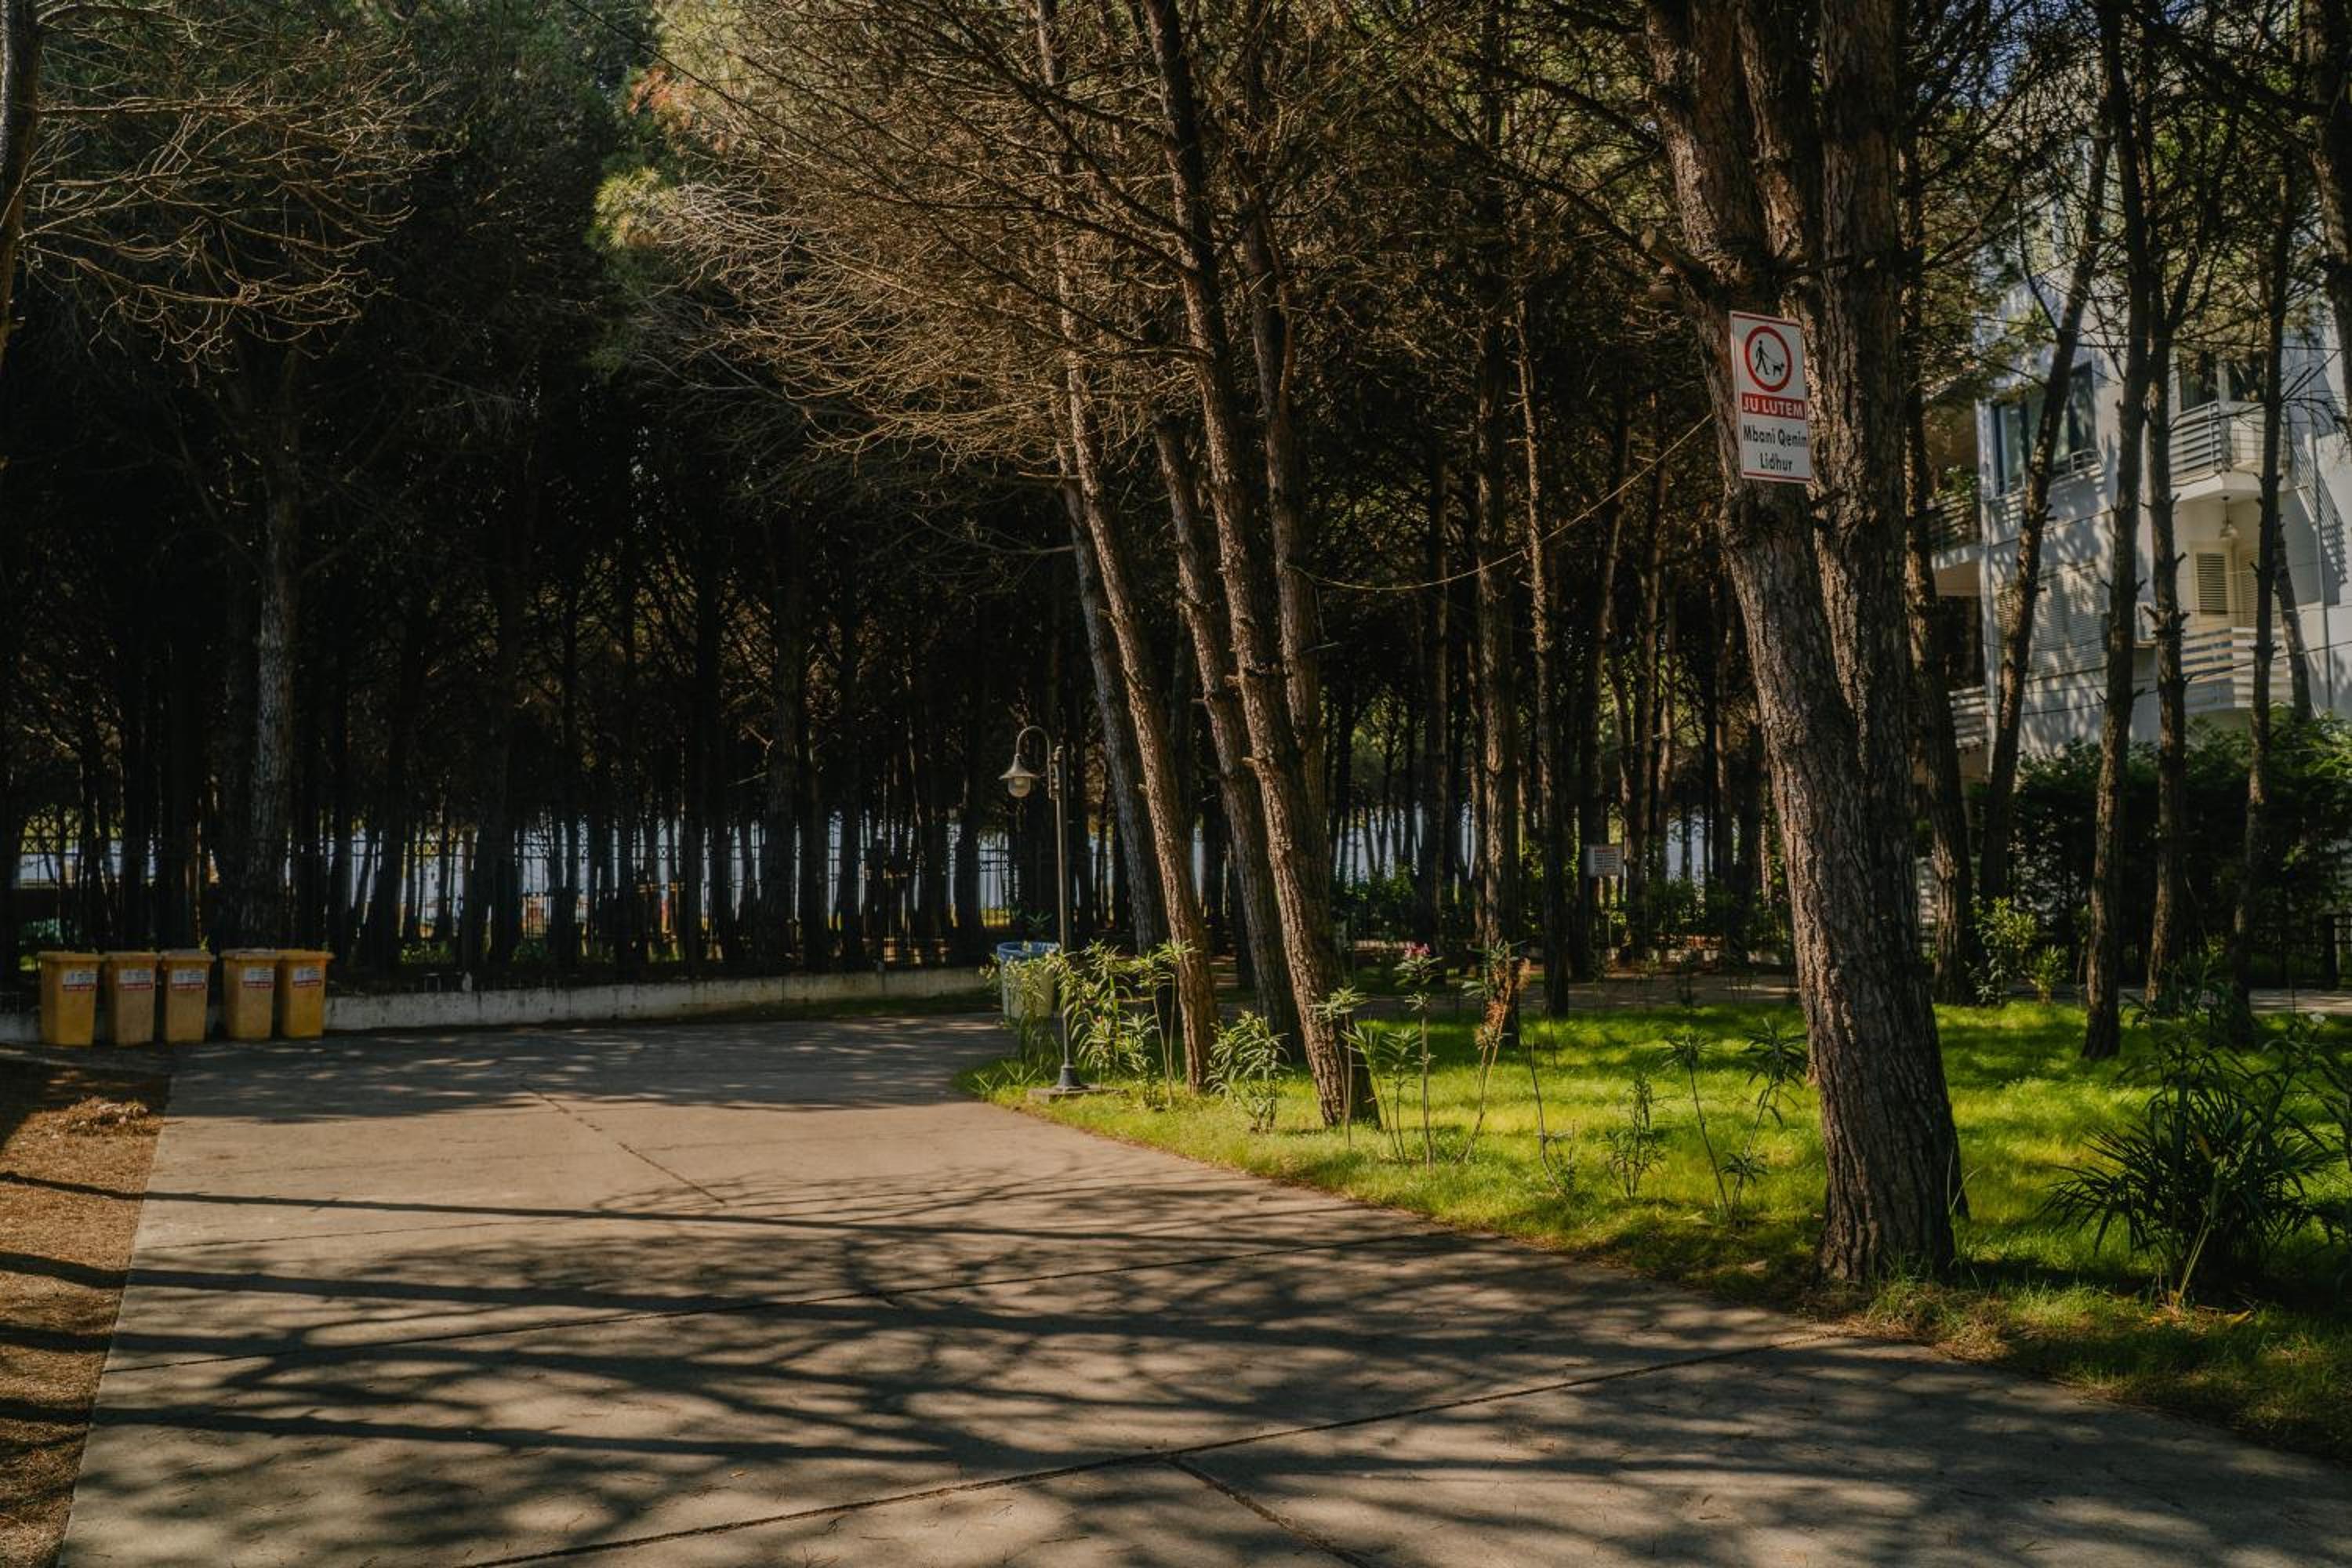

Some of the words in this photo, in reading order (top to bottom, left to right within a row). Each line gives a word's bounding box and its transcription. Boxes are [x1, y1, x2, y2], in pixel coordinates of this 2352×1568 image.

[1743, 395, 1759, 412] JU
[1762, 399, 1804, 418] LUTEM
[1743, 425, 1776, 445] Mbani
[1759, 452, 1793, 472] Lidhur
